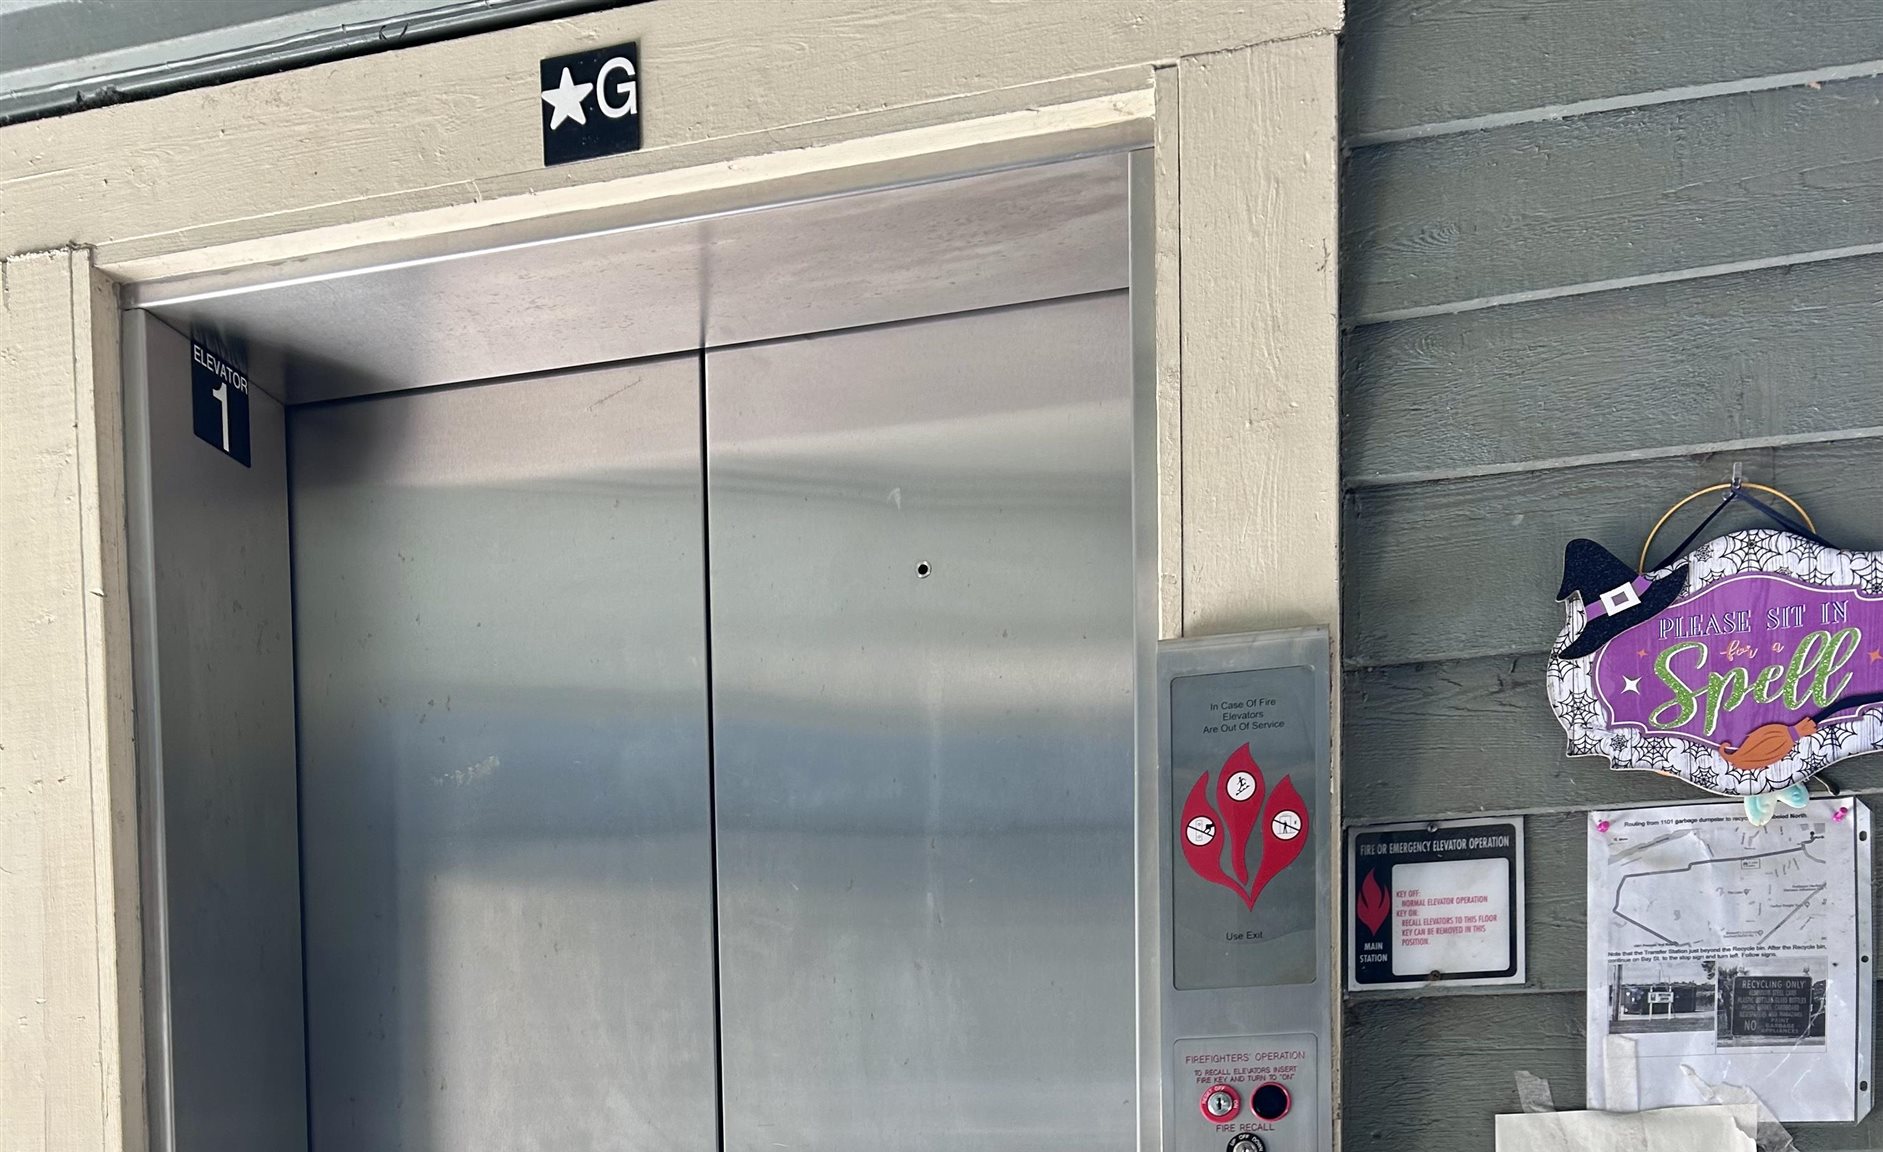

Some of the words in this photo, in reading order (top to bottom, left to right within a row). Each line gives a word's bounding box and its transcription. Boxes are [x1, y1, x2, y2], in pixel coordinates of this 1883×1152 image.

[596, 56, 638, 119] G
[193, 344, 248, 395] ELEVATOR
[212, 382, 229, 453] 1
[1658, 610, 1751, 640] PLEASE
[1766, 604, 1806, 631] SIT
[1820, 600, 1849, 625] IN
[1719, 639, 1759, 662] for
[1772, 642, 1785, 653] a
[1648, 627, 1862, 737] Spell
[1210, 703, 1219, 711] In
[1220, 701, 1244, 710] Case
[1246, 698, 1257, 708] Of
[1259, 697, 1276, 707] Fire
[1222, 711, 1264, 721] Elevators
[1203, 725, 1218, 734] Are
[1220, 723, 1237, 733] Out
[1239, 722, 1250, 731] Of
[1251, 720, 1285, 730] Service
[1698, 816, 1725, 824] dumpster
[1360, 844, 1375, 856] FIRE
[1377, 843, 1387, 855] OR
[1389, 841, 1431, 854] EMERGENCY
[1432, 838, 1467, 852] ELEVATOR
[1468, 835, 1510, 849] OPERATION
[1396, 890, 1407, 898] KEY
[1401, 899, 1425, 907] NORMAL
[1427, 897, 1454, 906] ELEVATOR
[1456, 895, 1488, 905] OPERATION
[1396, 909, 1407, 917] KEY
[1401, 918, 1422, 927] RECALL
[1423, 917, 1454, 926] ELEVATORS
[1455, 916, 1463, 924] TO
[1464, 915, 1477, 923] THIS
[1478, 914, 1498, 923] FLOOR
[1226, 932, 1243, 941] Use
[1246, 930, 1263, 940] Exit
[1401, 929, 1413, 937] KEY
[1413, 928, 1426, 936] CAN
[1427, 927, 1434, 936] BE
[1435, 926, 1463, 935] REMOVED
[1464, 925, 1472, 933] IN
[1473, 924, 1486, 933] THIS
[1363, 942, 1384, 951] MAIN
[1359, 953, 1388, 963] STATION
[1742, 979, 1783, 989] RECYCLING
[1785, 979, 1806, 989] ONLY
[1744, 1019, 1757, 1031] NO
[1254, 1051, 1305, 1062] OPERATION
[1194, 1069, 1202, 1077] TO
[1204, 1068, 1231, 1076] RECALL
[1233, 1066, 1271, 1075] ELEVATORS
[1273, 1065, 1297, 1073] INSERT
[1196, 1076, 1211, 1084] FIRE
[1213, 1075, 1228, 1083] KEY
[1229, 1075, 1245, 1083] AND
[1247, 1074, 1266, 1082] TURN
[1268, 1073, 1277, 1081] TO
[1215, 1124, 1236, 1133] FIRE
[1239, 1123, 1275, 1132] RECALL
[1229, 1138, 1237, 1147] UP
[1251, 1136, 1264, 1152] DOWN
